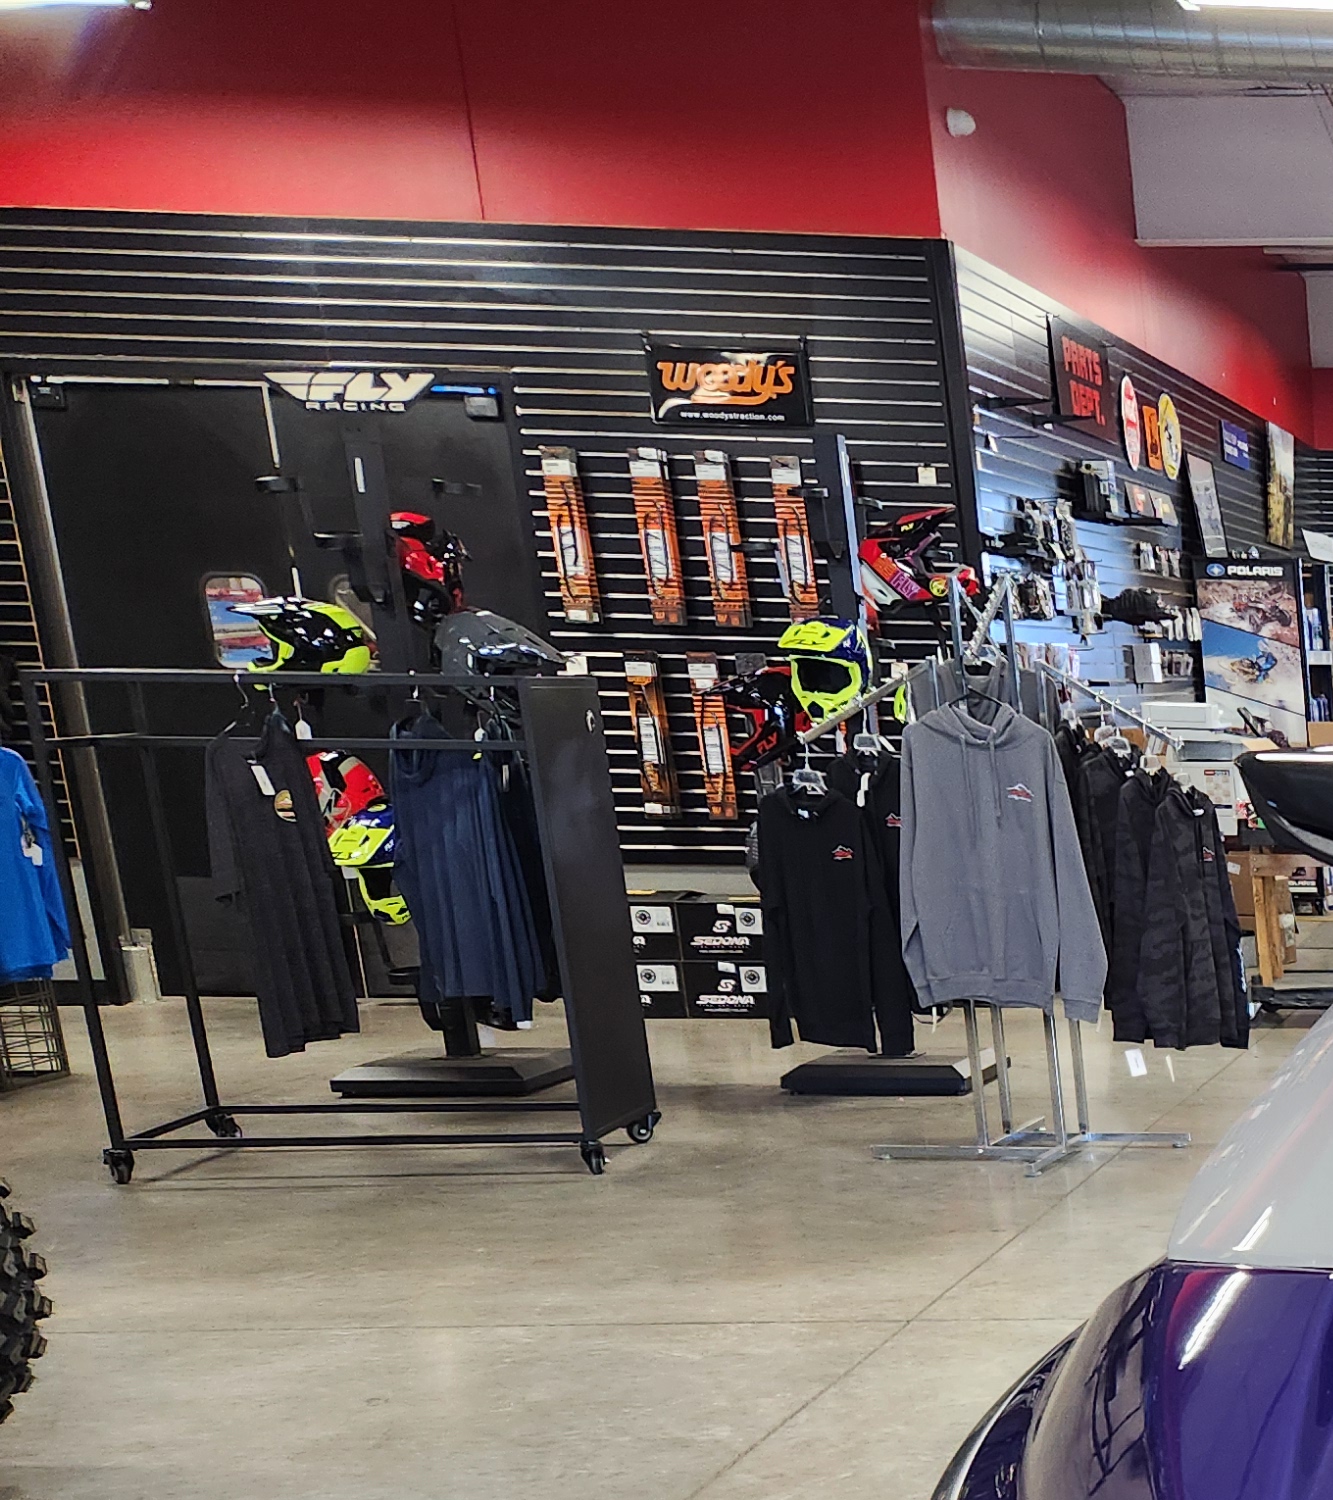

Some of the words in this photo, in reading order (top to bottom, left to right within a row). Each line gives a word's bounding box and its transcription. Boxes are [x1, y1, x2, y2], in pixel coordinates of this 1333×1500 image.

[1061, 335, 1103, 386] PARTS
[300, 371, 435, 401] FLY
[305, 401, 407, 412] RACING
[901, 523, 915, 532] FLY
[1227, 565, 1284, 577] POLARIS
[756, 731, 778, 754] FLY
[689, 936, 751, 946] SEDONA
[695, 995, 756, 1005] SEDONA
